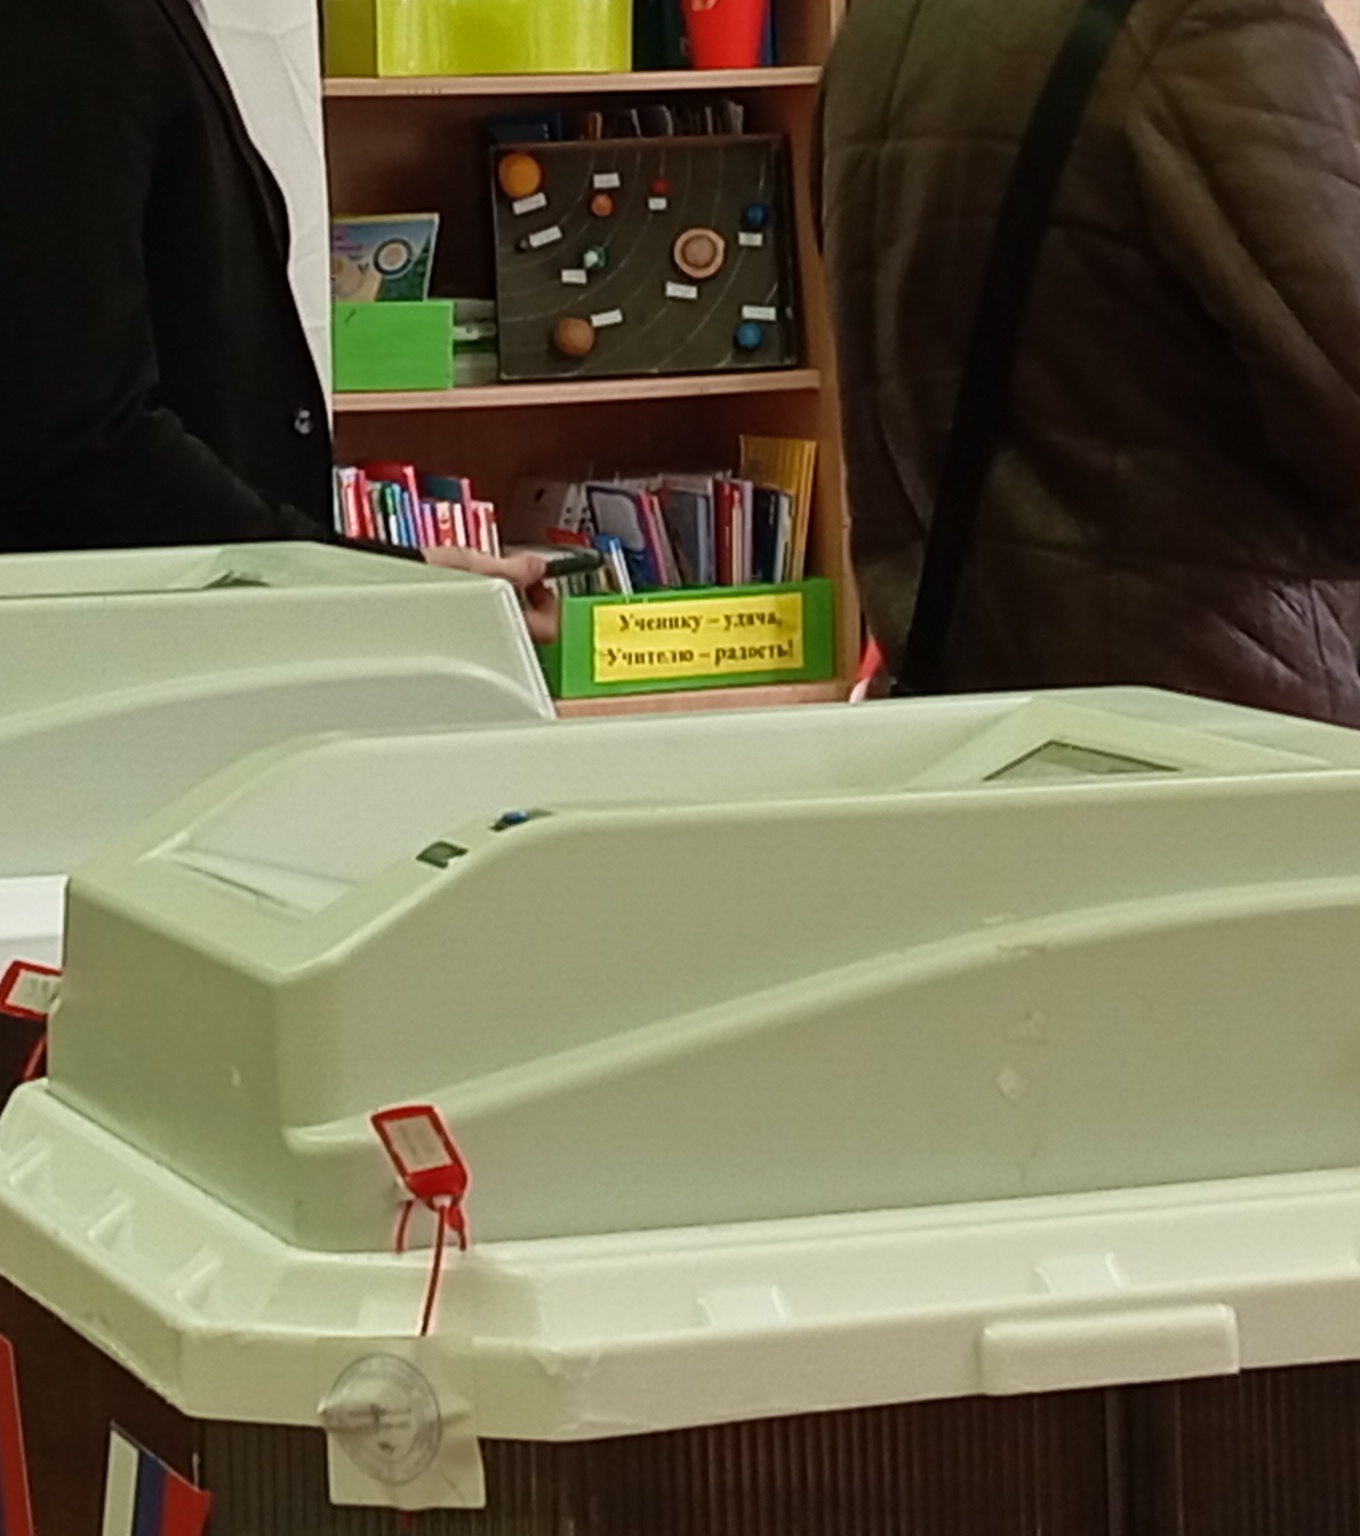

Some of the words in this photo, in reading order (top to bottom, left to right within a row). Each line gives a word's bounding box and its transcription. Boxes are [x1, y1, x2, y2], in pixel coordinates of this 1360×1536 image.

[619, 613, 703, 633] Ученику
[722, 610, 783, 631] удача,
[607, 647, 694, 666] Учителю
[714, 637, 794, 666] радость!
